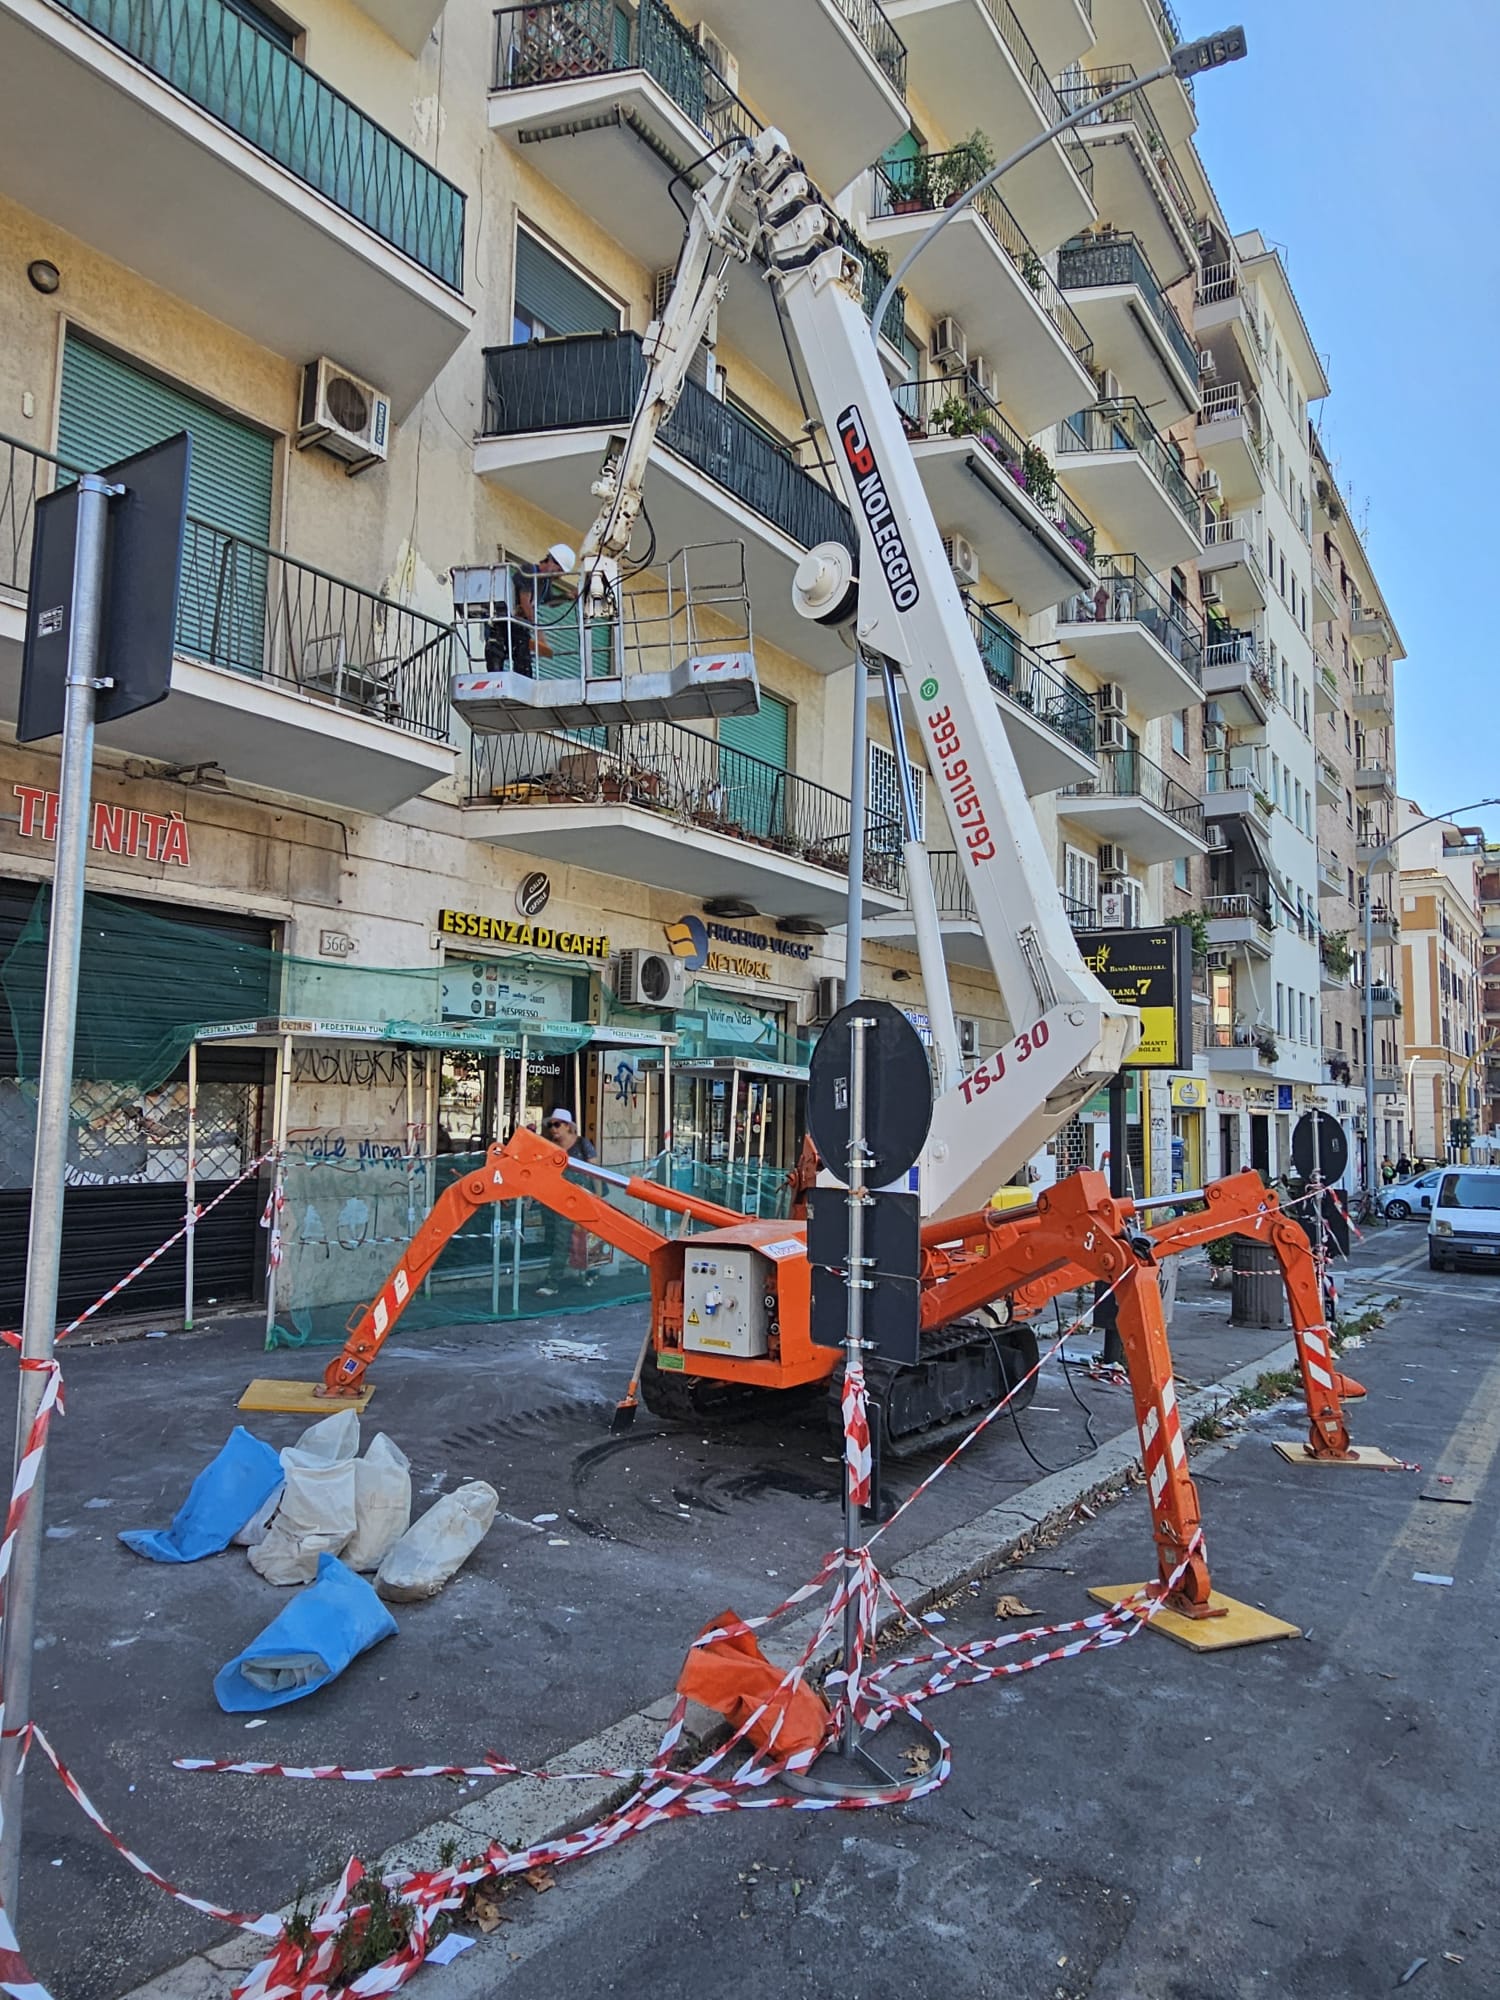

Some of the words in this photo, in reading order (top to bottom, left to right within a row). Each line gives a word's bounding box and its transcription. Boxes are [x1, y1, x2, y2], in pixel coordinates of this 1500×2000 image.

[839, 407, 873, 474] TOP
[858, 471, 918, 608] NOLEGGIO
[927, 705, 995, 867] 393.9115792
[14, 785, 190, 866] TRNITÀ
[441, 909, 533, 946] ESSENZA
[535, 926, 557, 949] DI
[707, 922, 768, 950] FRIGERIO
[324, 935, 346, 952] 366
[708, 952, 771, 979] NETWORK
[1136, 978, 1152, 995] 7
[320, 1022, 367, 1032] PEDESTRIAN
[707, 1007, 725, 1022] Vivir
[734, 1010, 752, 1025] Vida
[421, 1029, 461, 1040] PEDESTRIAN
[462, 1031, 487, 1040] TUNNEL
[958, 1052, 1006, 1104] TSJ
[1014, 1019, 1049, 1062] 30
[1084, 1231, 1095, 1251] 3
